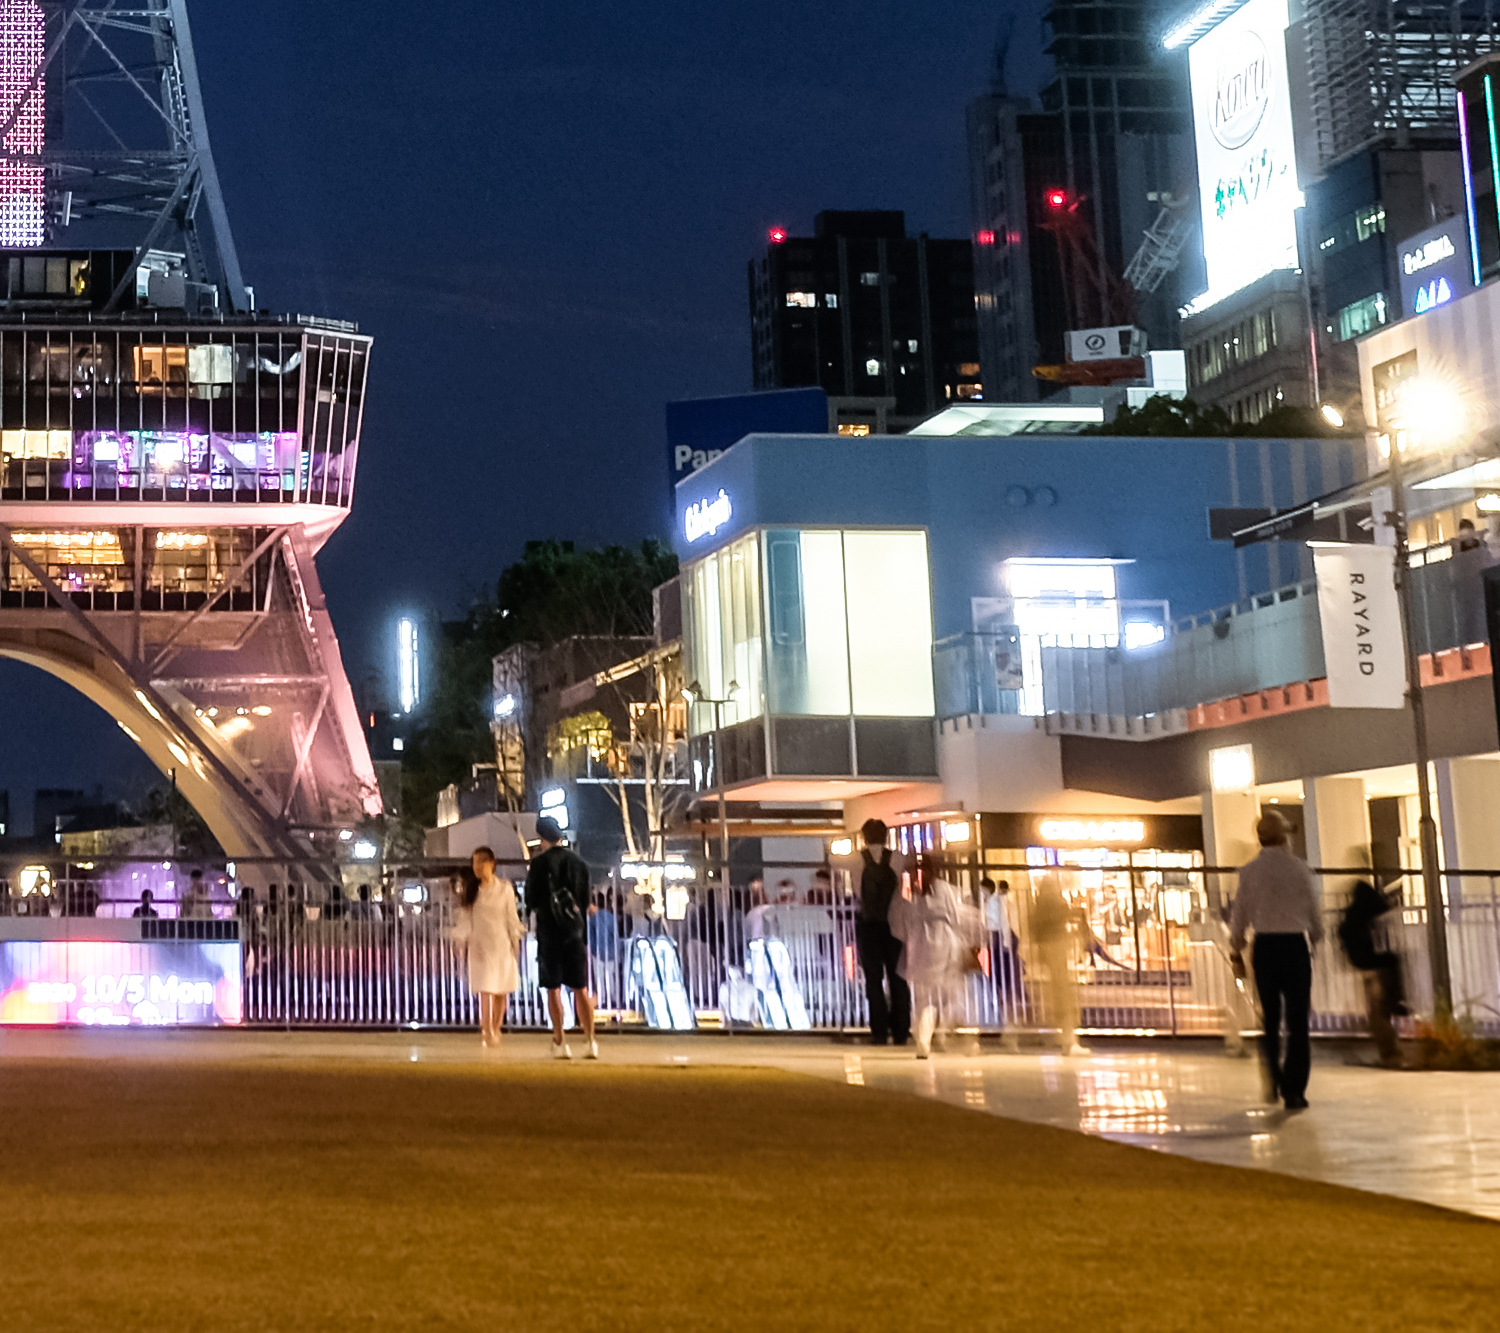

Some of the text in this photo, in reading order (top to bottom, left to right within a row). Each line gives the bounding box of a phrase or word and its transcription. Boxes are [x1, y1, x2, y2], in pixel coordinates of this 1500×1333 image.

[1349, 573, 1375, 676] RAYARD
[81, 973, 145, 1005] 10/5
[150, 974, 213, 1005] Mon
